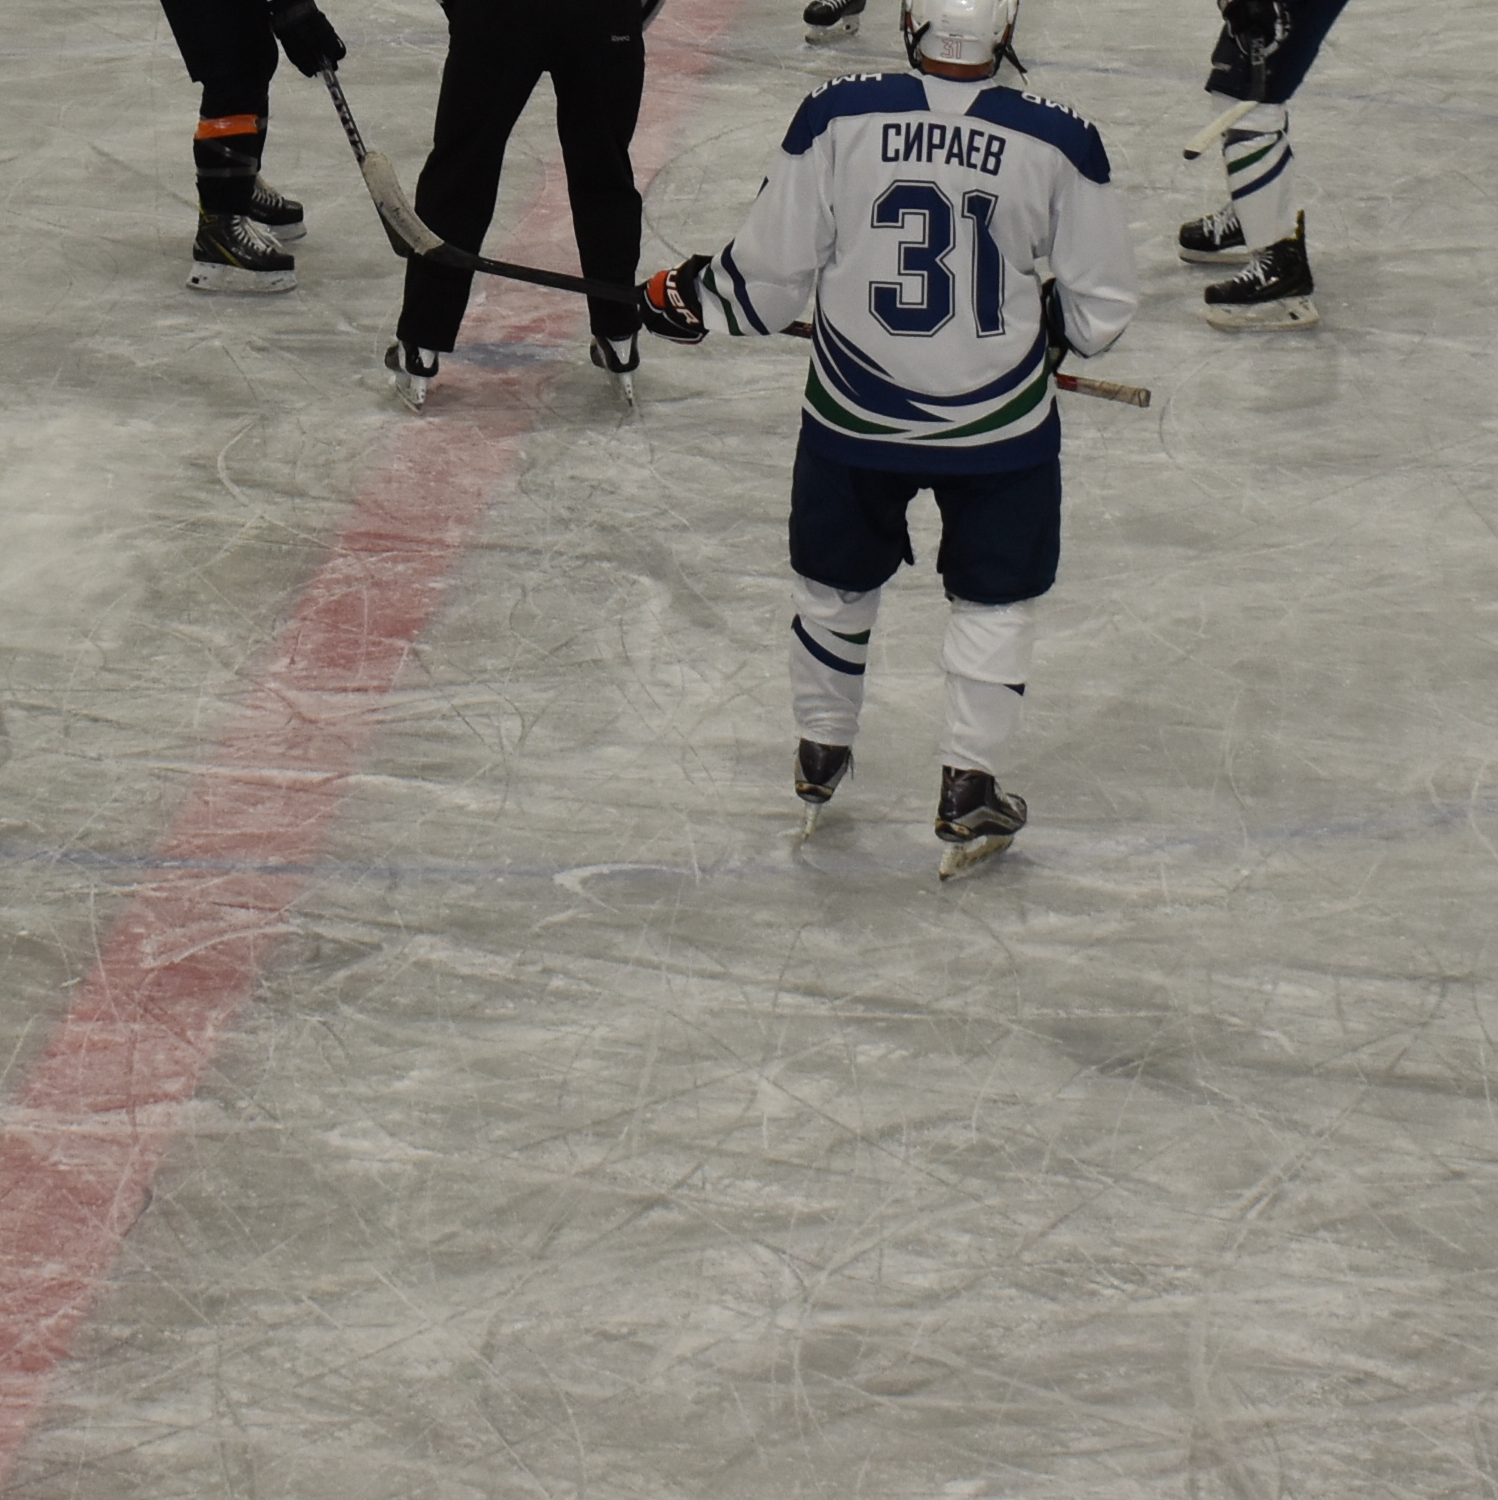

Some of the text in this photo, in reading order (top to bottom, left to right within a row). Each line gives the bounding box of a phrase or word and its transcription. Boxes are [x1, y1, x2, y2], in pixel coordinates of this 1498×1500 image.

[941, 40, 961, 60] 31
[881, 121, 1006, 177] СИРАЕВ
[868, 179, 1006, 338] 31
